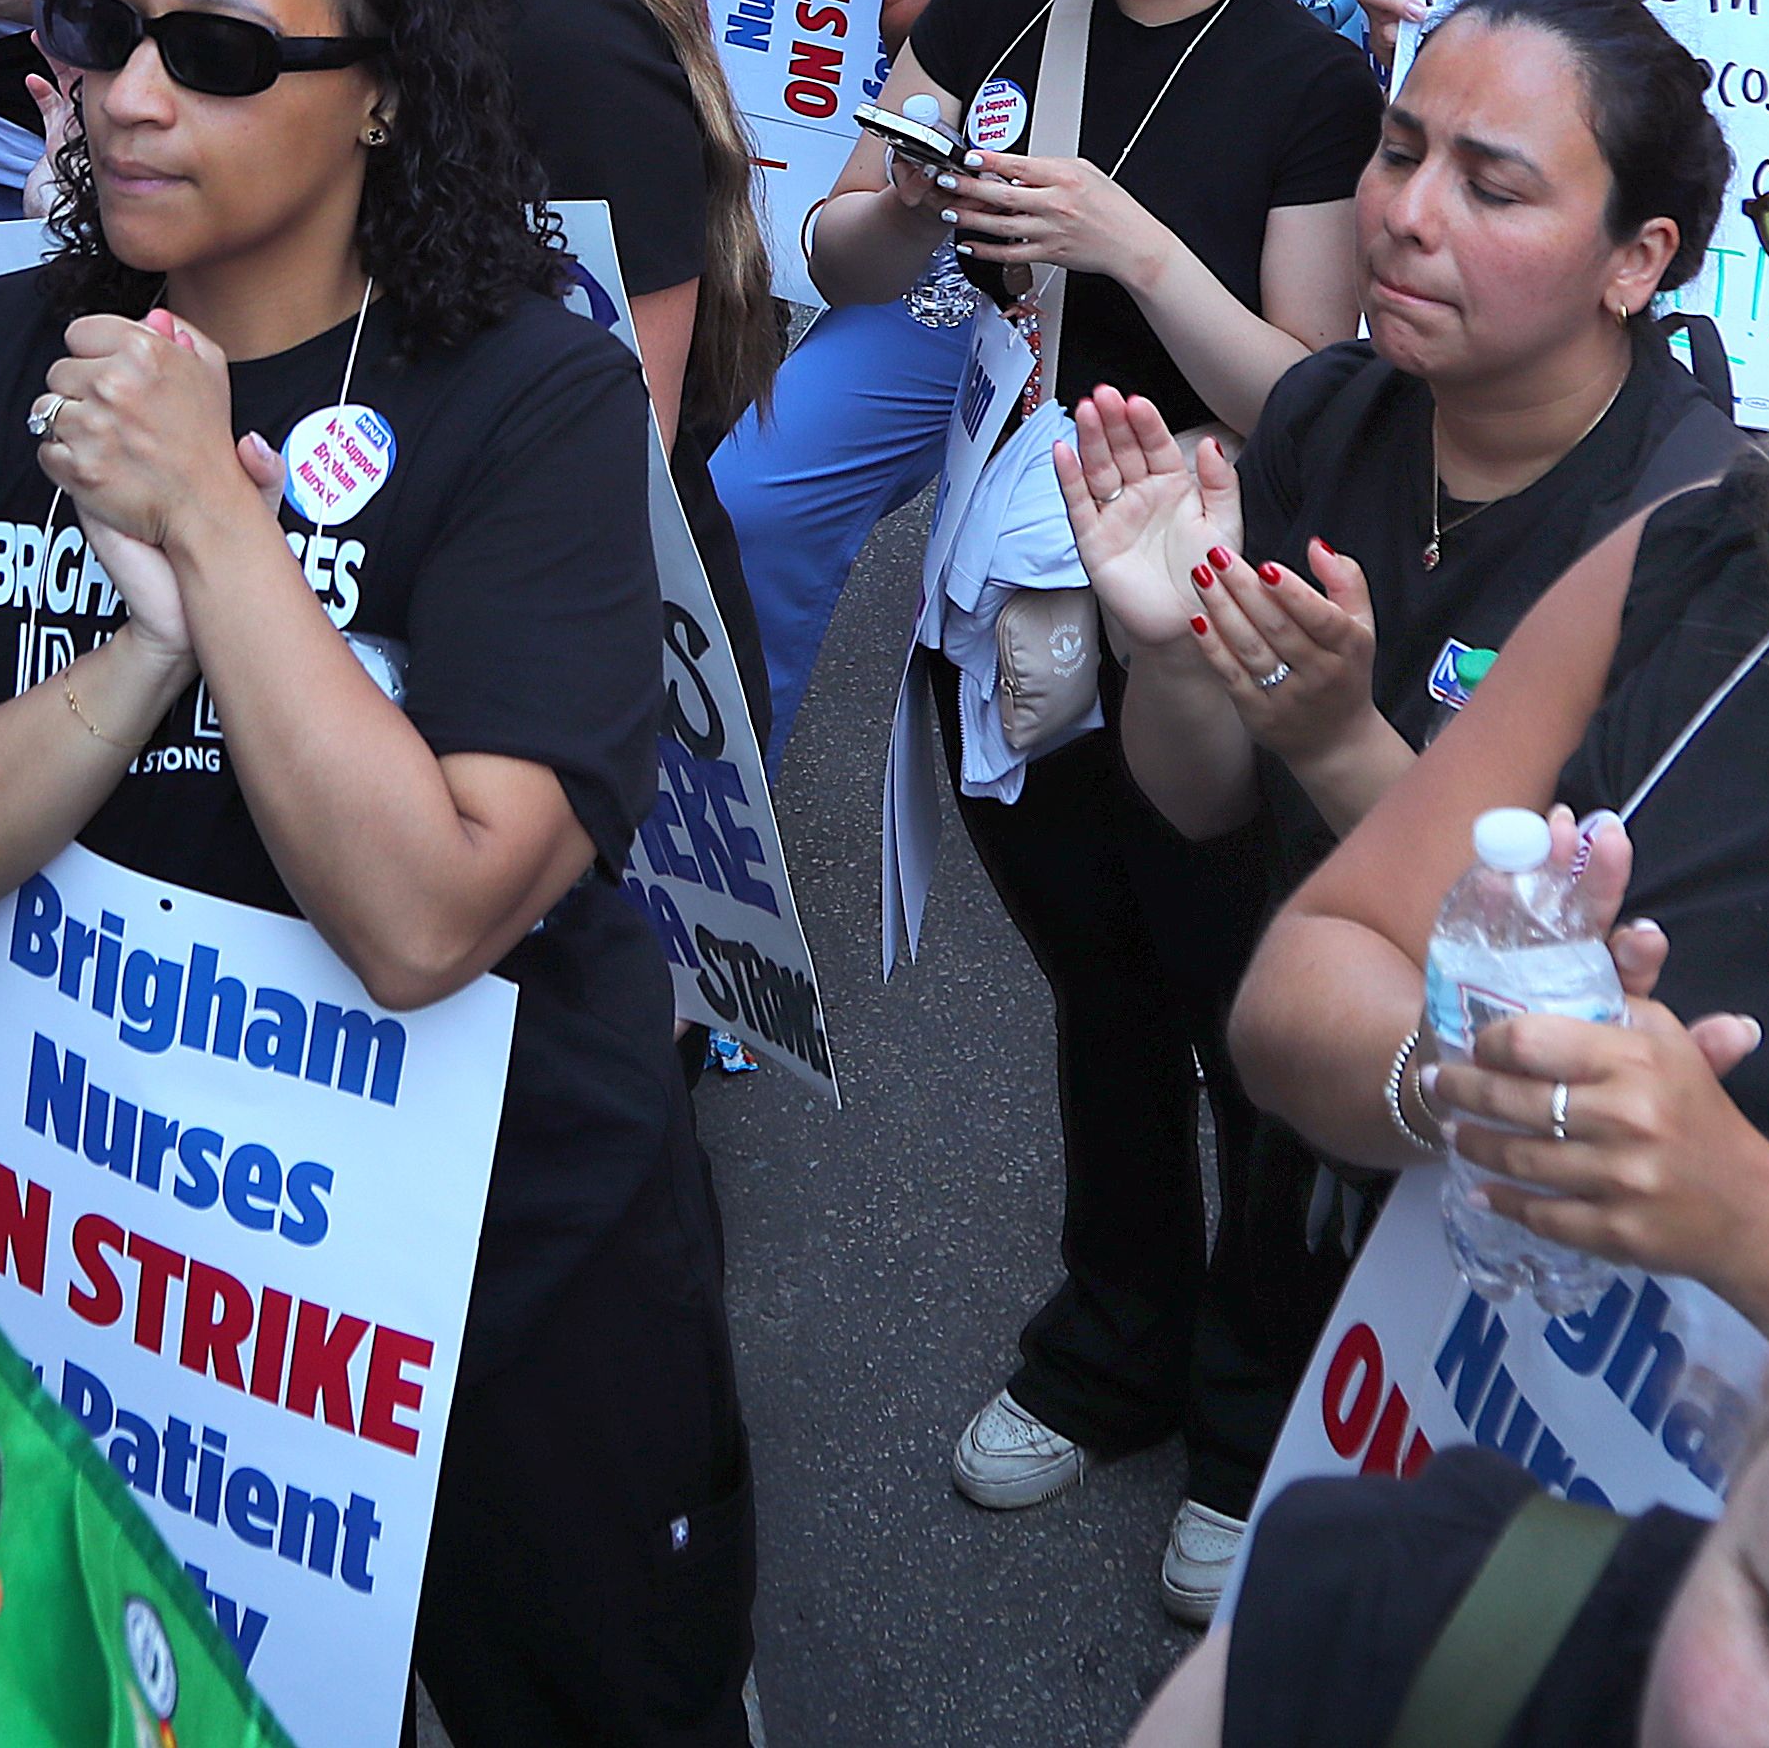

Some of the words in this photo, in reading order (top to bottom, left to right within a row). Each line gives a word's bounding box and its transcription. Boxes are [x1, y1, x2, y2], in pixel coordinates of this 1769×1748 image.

[783, 39, 845, 120] ON
[985, 96, 1018, 112] Support
[340, 435, 382, 483] Support
[357, 414, 385, 447] MNA
[7, 864, 411, 1110] Brigham
[24, 1033, 336, 1250] Nurses
[67, 1212, 437, 1458] STRIKE
[59, 1356, 382, 1595] Patient
